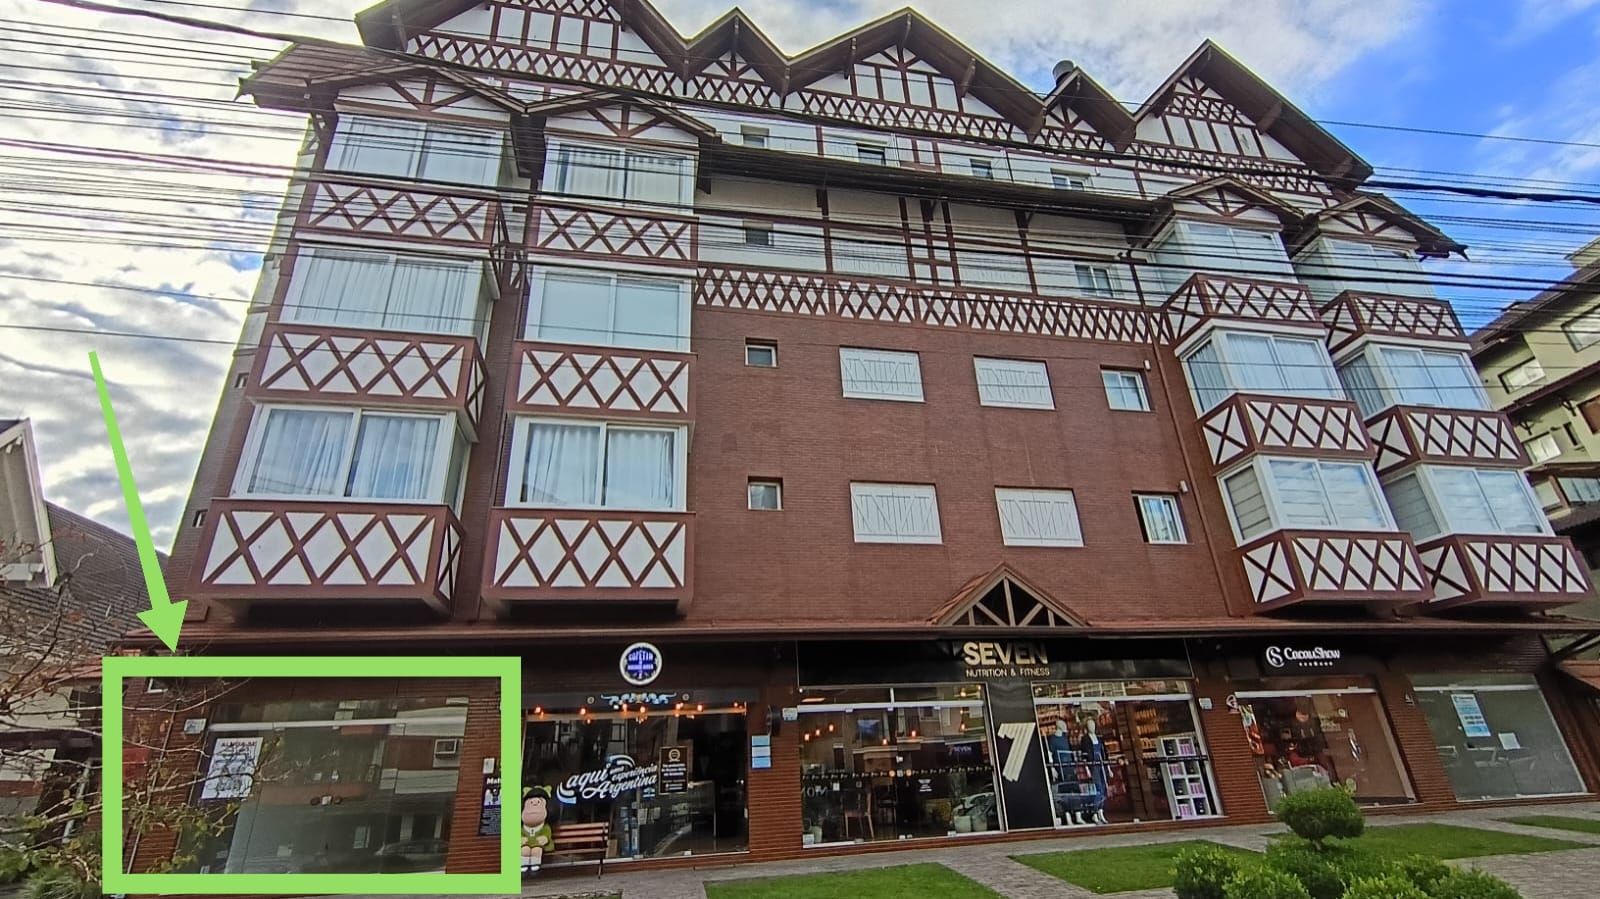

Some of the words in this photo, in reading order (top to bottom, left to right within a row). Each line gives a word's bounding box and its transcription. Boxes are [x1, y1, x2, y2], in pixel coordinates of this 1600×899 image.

[963, 641, 1049, 666] SEVEN
[966, 668, 1007, 678] NUTRITION
[1010, 668, 1017, 677] &
[1020, 667, 1050, 677] FITNESS
[997, 722, 1035, 782] 7
[582, 774, 658, 799] Argentina
